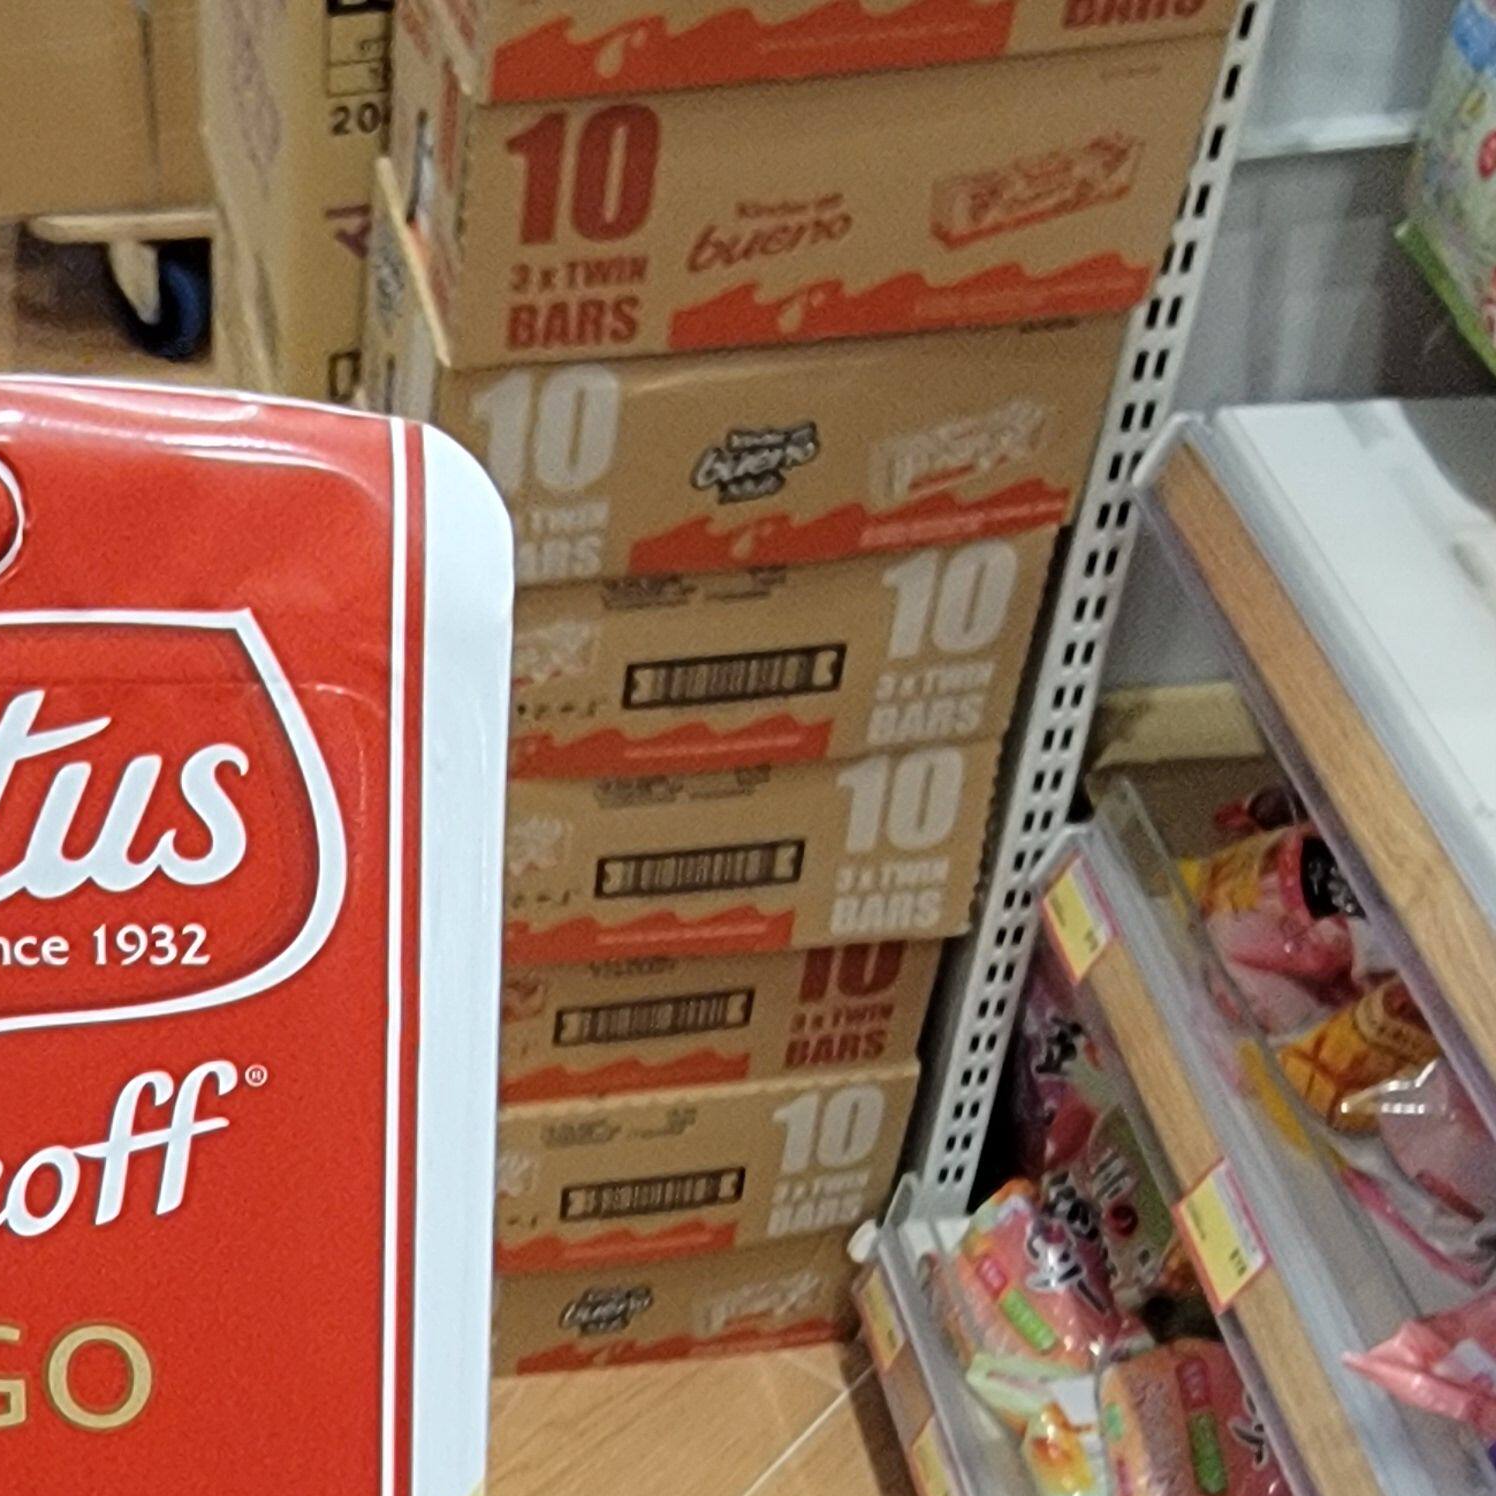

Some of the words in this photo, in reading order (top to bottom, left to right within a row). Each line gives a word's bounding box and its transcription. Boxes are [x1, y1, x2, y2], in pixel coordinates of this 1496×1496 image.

[507, 104, 661, 245] 10
[685, 213, 853, 273] bueno
[566, 256, 649, 290] TWIN
[507, 296, 640, 350] BARS
[469, 362, 620, 497] 10
[882, 539, 1017, 660] 10
[867, 695, 985, 747] BARS
[837, 747, 964, 855] 10
[831, 892, 941, 935] BARS
[93, 923, 211, 967] 1932
[785, 1029, 887, 1067] BARS
[773, 1084, 885, 1174] 10
